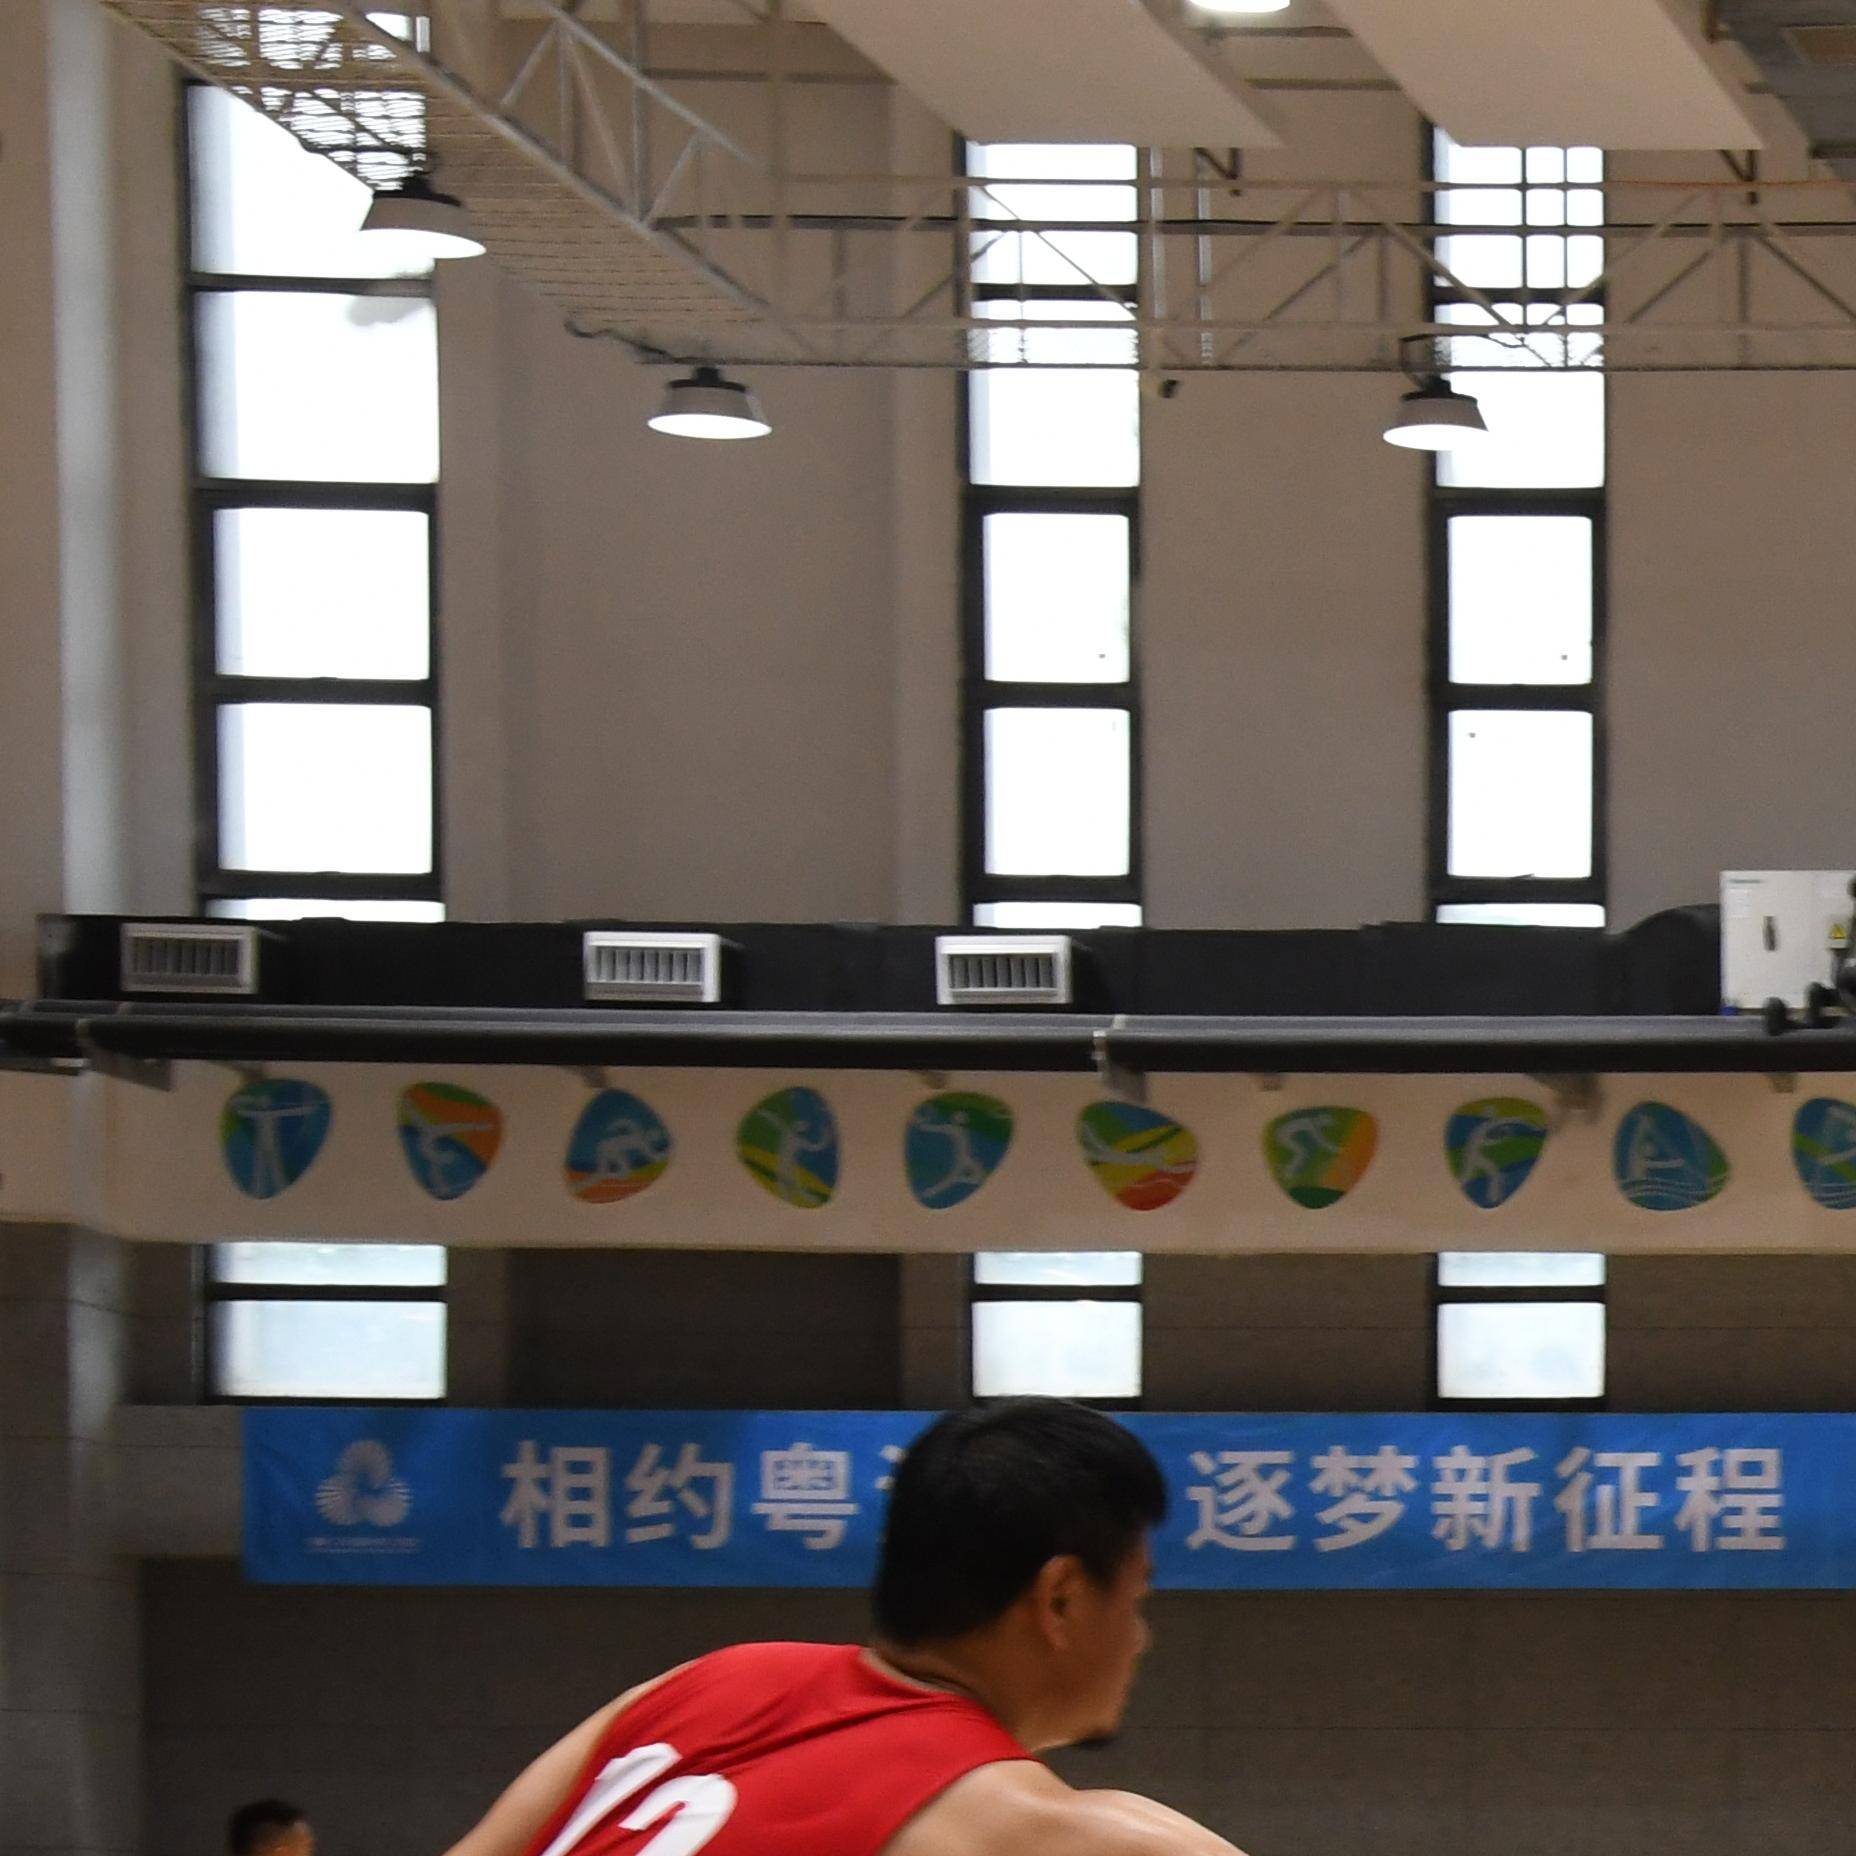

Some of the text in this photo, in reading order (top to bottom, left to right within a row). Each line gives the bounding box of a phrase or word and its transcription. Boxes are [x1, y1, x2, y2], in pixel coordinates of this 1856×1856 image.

[500, 1439, 1787, 1554] 相约粤 逐梦新征程
